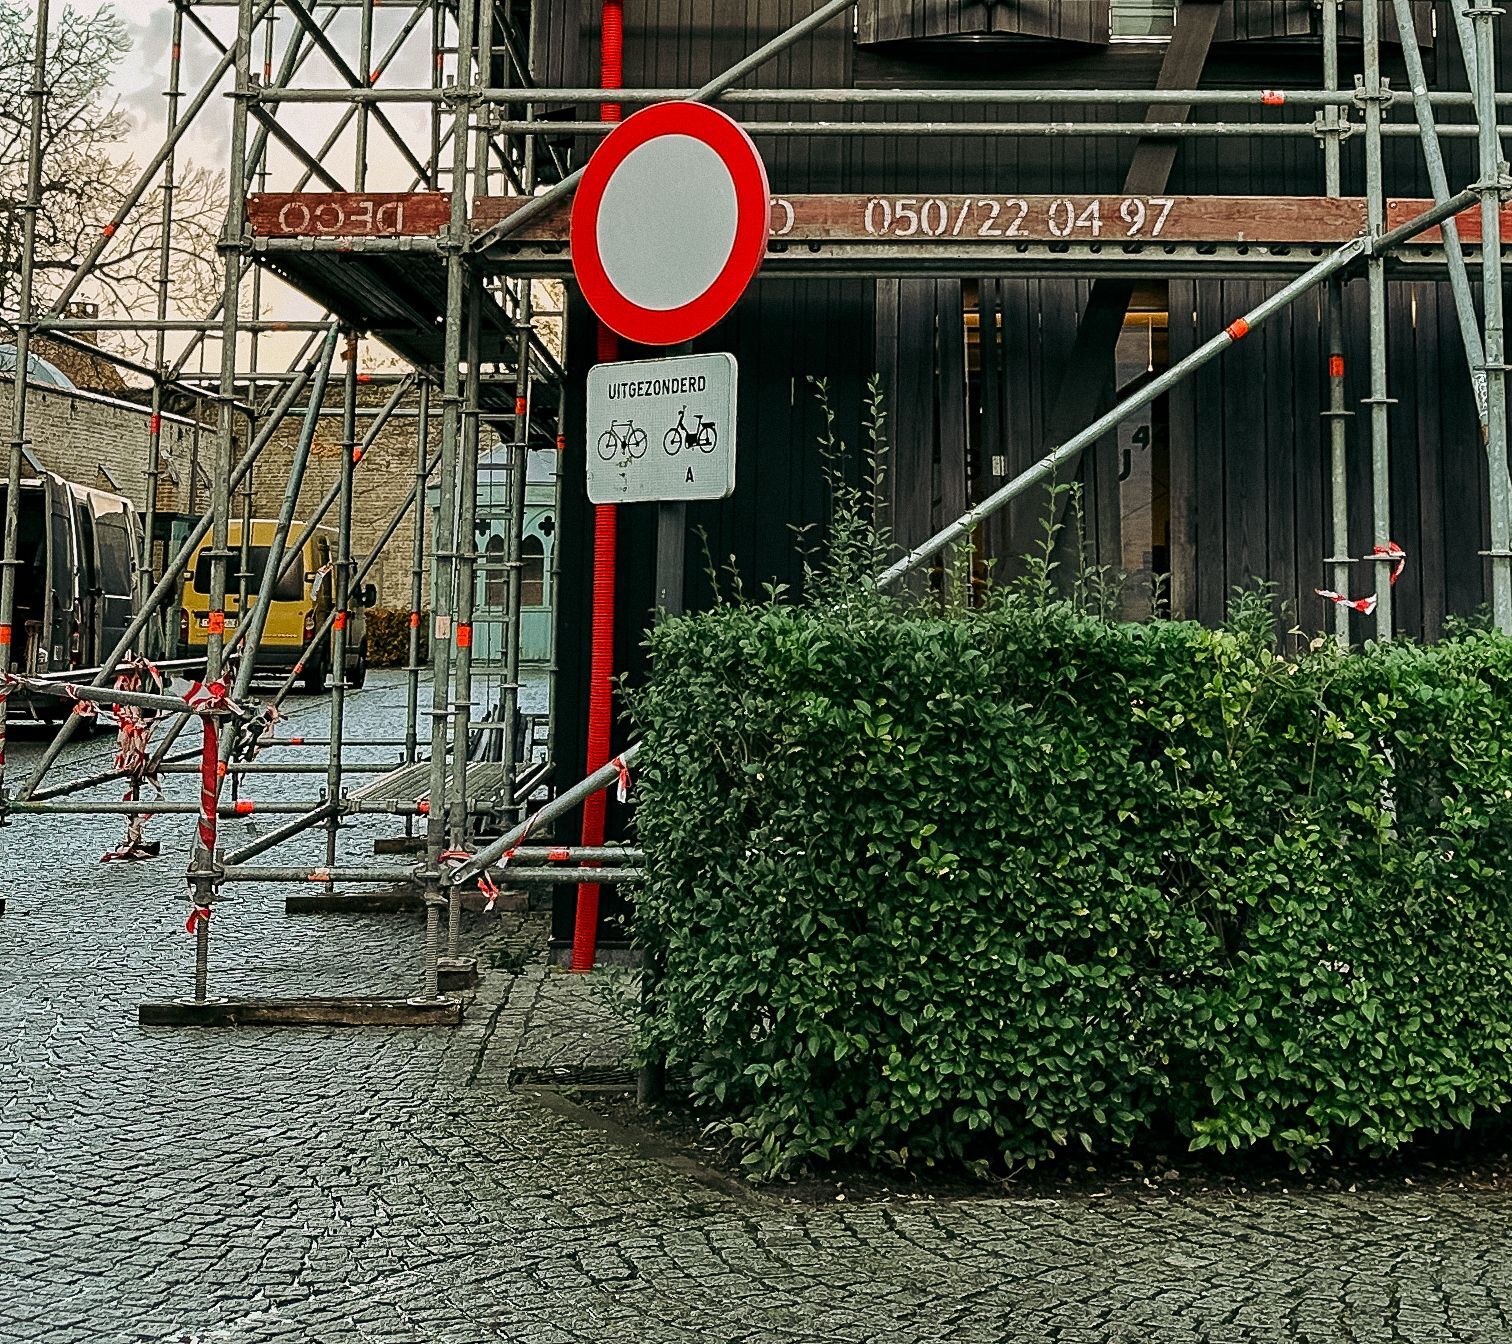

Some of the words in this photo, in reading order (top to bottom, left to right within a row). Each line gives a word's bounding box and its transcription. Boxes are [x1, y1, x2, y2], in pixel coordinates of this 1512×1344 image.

[864, 197, 1029, 236] 050/22
[1048, 199, 1102, 238] 04
[1120, 199, 1176, 238] 97
[608, 376, 706, 400] UITGEZONDERD
[685, 467, 694, 483] A
